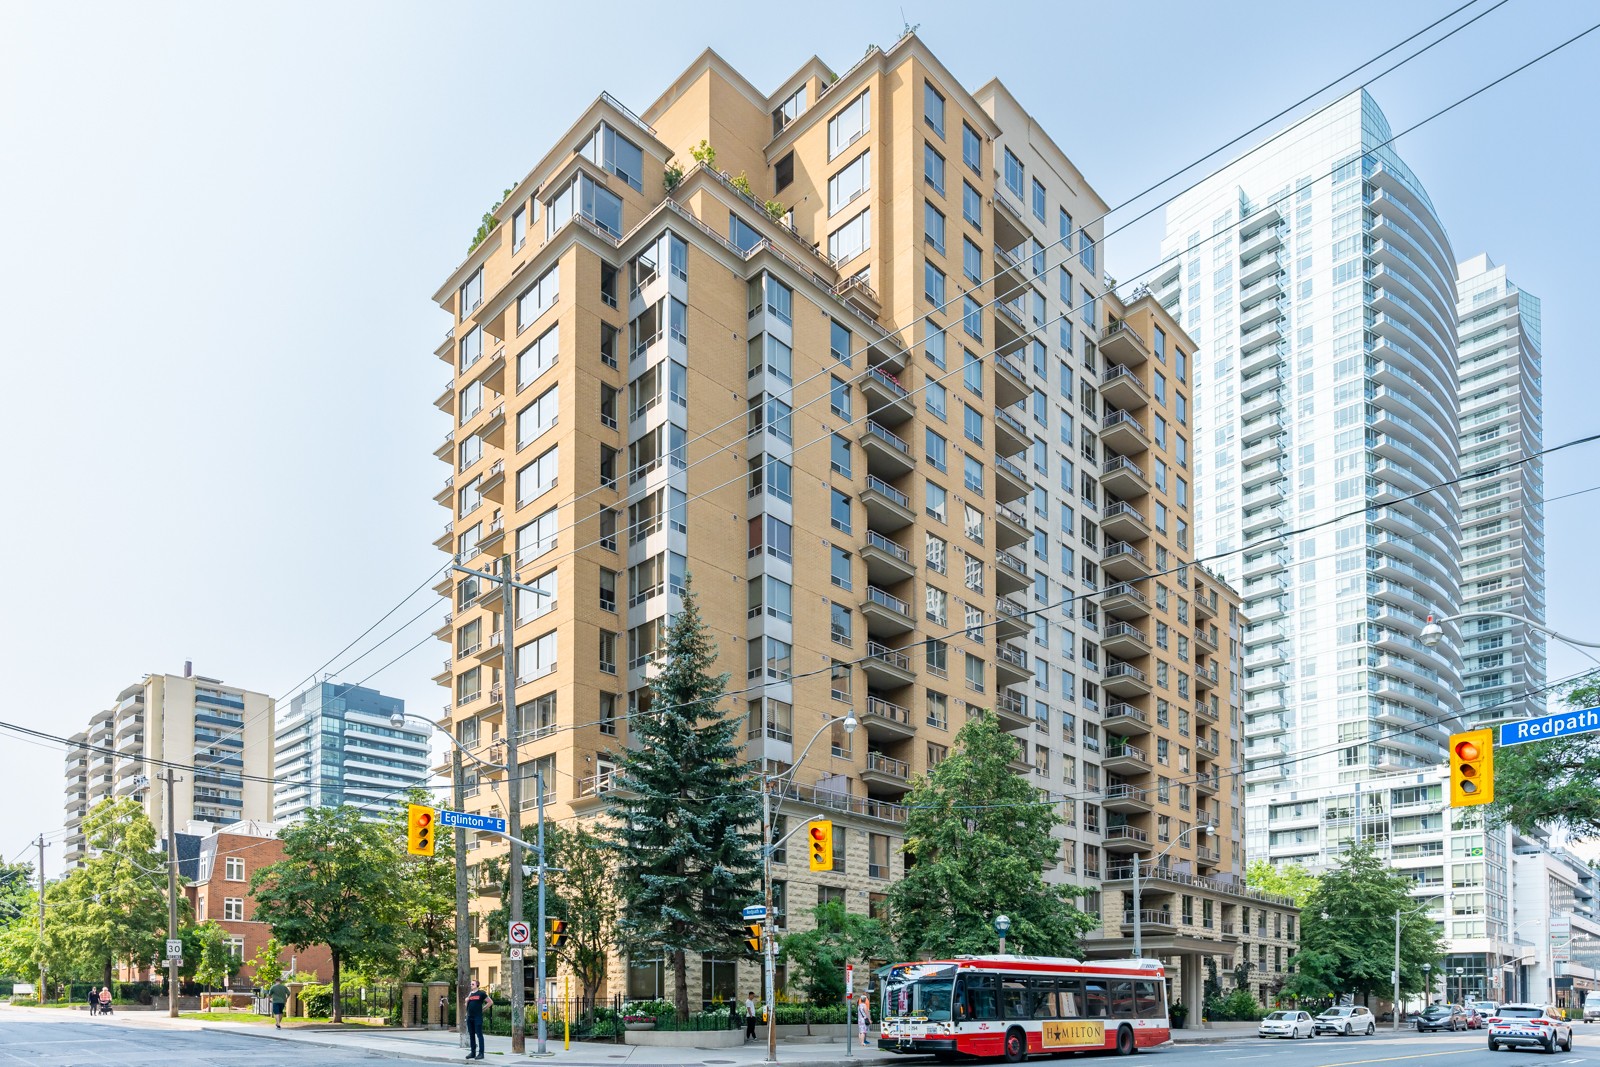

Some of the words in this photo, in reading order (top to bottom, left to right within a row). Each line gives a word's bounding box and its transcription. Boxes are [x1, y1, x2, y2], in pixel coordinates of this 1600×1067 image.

[1518, 711, 1598, 738] Redpath
[445, 812, 484, 827] Eglinton
[496, 819, 502, 829] E
[168, 945, 181, 953] 30
